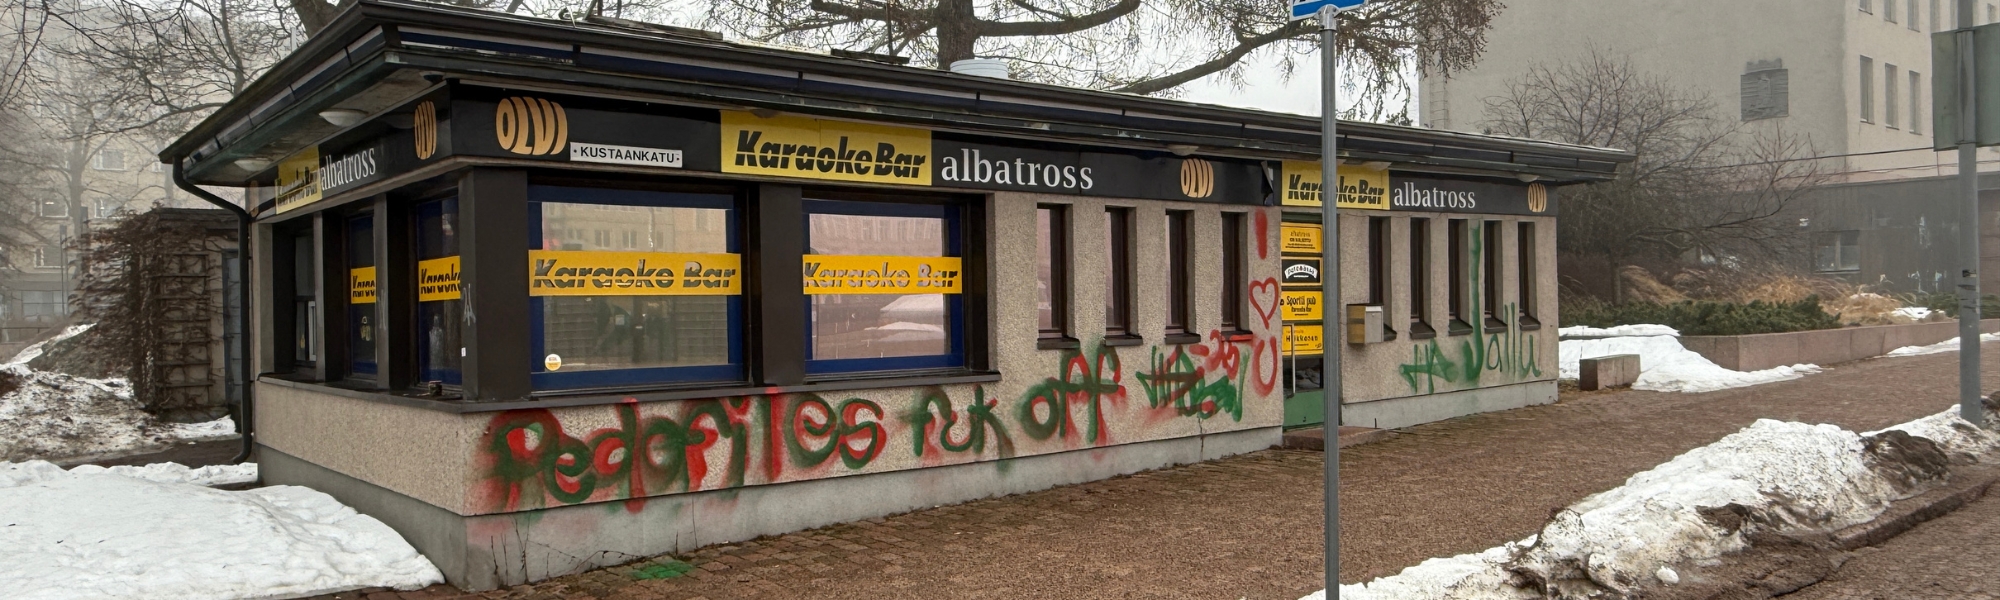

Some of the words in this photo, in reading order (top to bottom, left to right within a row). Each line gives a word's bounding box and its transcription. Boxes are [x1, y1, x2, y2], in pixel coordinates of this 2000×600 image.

[496, 97, 568, 155] OLVI
[320, 147, 376, 191] albatross
[579, 146, 675, 163] KUSTAANKATU
[735, 130, 872, 176] Karaoke
[873, 142, 926, 179] Bar
[942, 148, 1094, 190] albatross
[1180, 158, 1214, 198] OLVI
[1288, 173, 1357, 204] Karke
[1358, 179, 1385, 205] Bar
[1394, 181, 1476, 208] albatross
[533, 258, 675, 289] Karaoke
[683, 261, 736, 288] Bar
[803, 262, 910, 289] Karaoke
[916, 263, 959, 288] Bar
[1020, 341, 1127, 446] off
